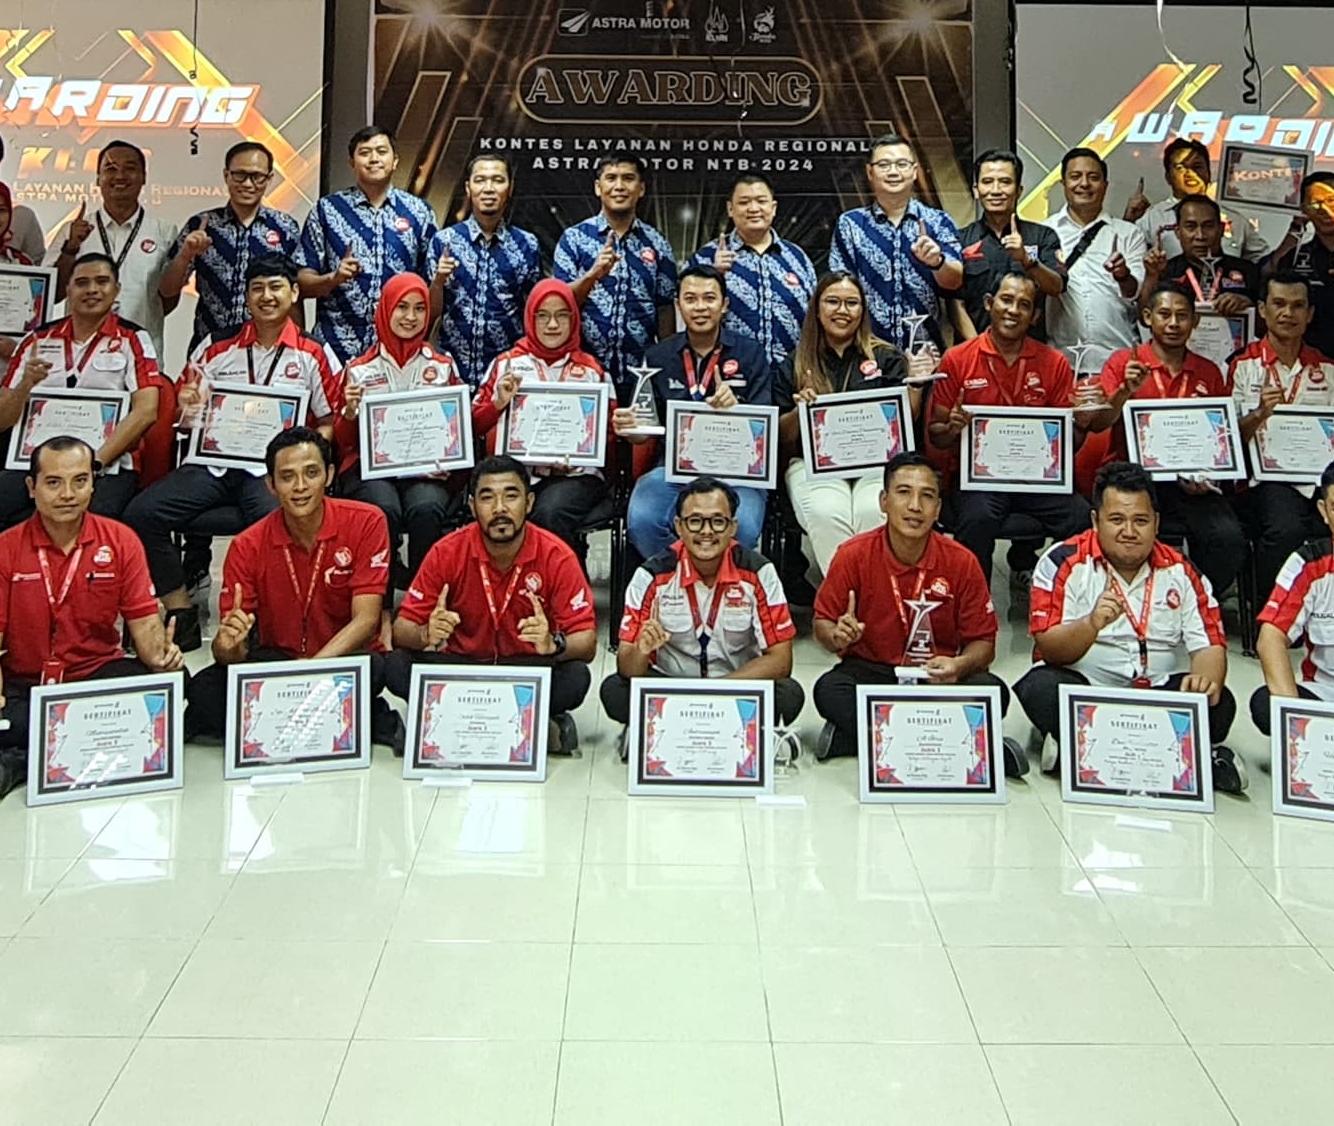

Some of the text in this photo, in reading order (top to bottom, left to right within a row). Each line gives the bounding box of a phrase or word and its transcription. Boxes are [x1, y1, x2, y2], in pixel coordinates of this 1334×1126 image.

[592, 17, 691, 30] ASTRA MOTOR
[526, 68, 812, 107] AWARDING
[480, 138, 870, 152] KONTES LAYANAN HONDA REGIONAL
[707, 158, 750, 171] NTB
[761, 159, 813, 171] 2024
[13, 181, 85, 194] LAYANAN
[151, 184, 230, 197] REGIONA
[17, 192, 58, 202] STRA
